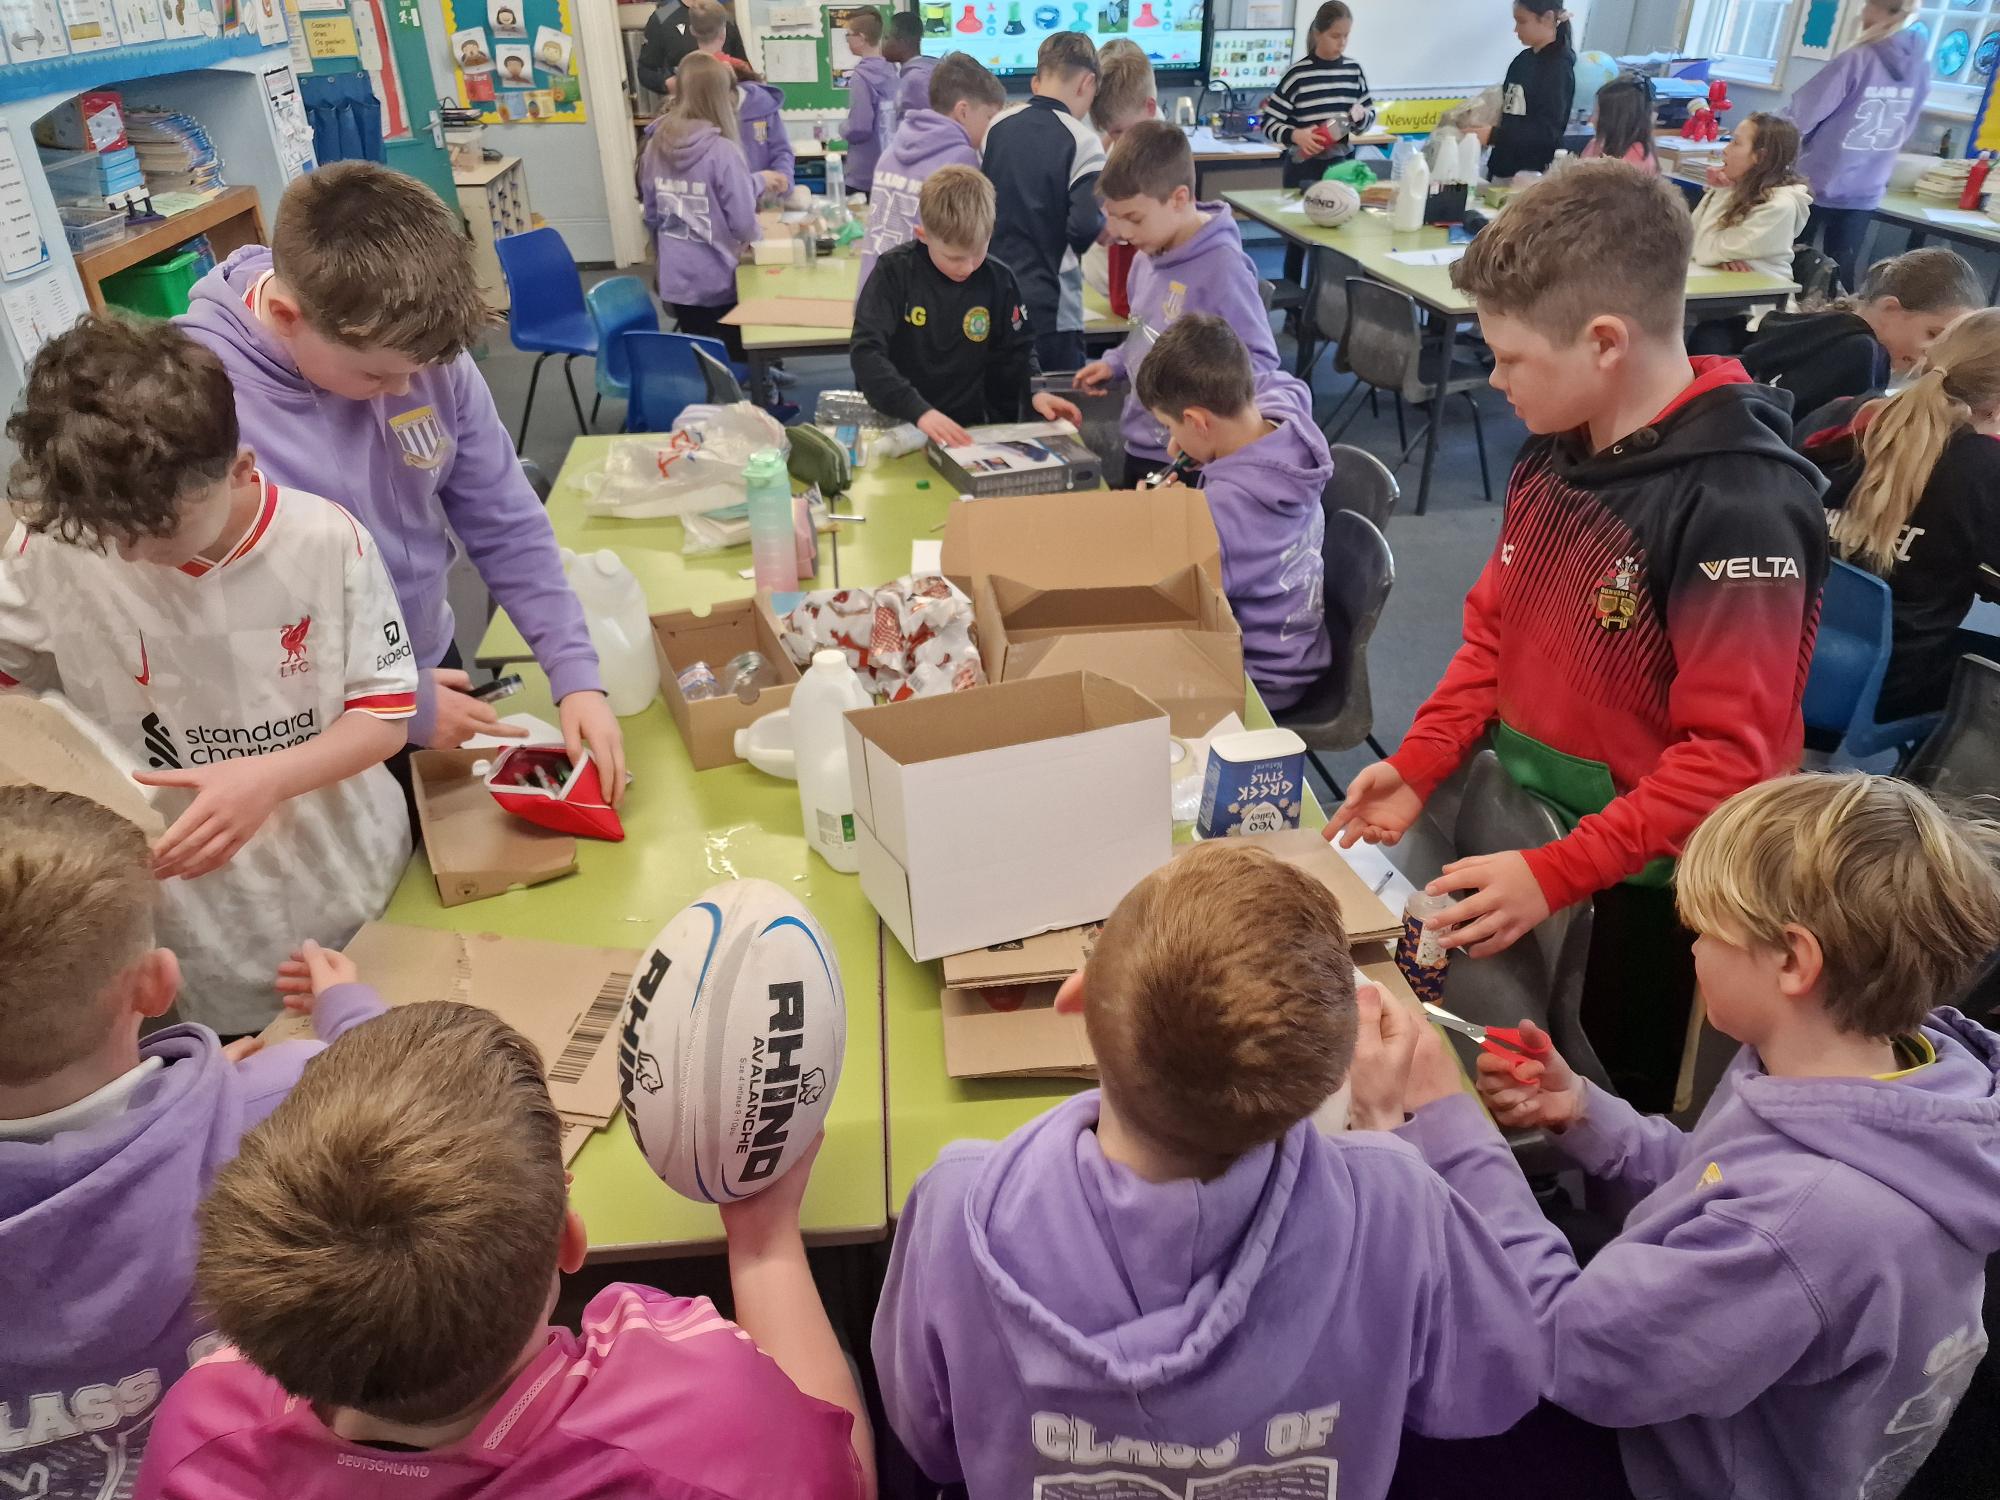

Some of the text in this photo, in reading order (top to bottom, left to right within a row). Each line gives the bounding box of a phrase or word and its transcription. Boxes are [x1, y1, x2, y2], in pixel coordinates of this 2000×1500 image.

[1385, 112, 1438, 130] Newydd
[1842, 98, 1913, 151] 25
[1698, 556, 1800, 581] VELTA
[185, 708, 314, 745] standard
[1236, 780, 1294, 801] GREEK
[1250, 770, 1284, 784] STYLE
[1248, 820, 1275, 833] Yeo
[1249, 811, 1277, 822] Valley
[735, 1036, 765, 1155] AVALANCHE
[737, 980, 805, 1184] RHINO
[0, 1367, 163, 1452] LASS
[1031, 1400, 1341, 1470] CLASS OF
[336, 1452, 431, 1479] DEUTSCHLAND
